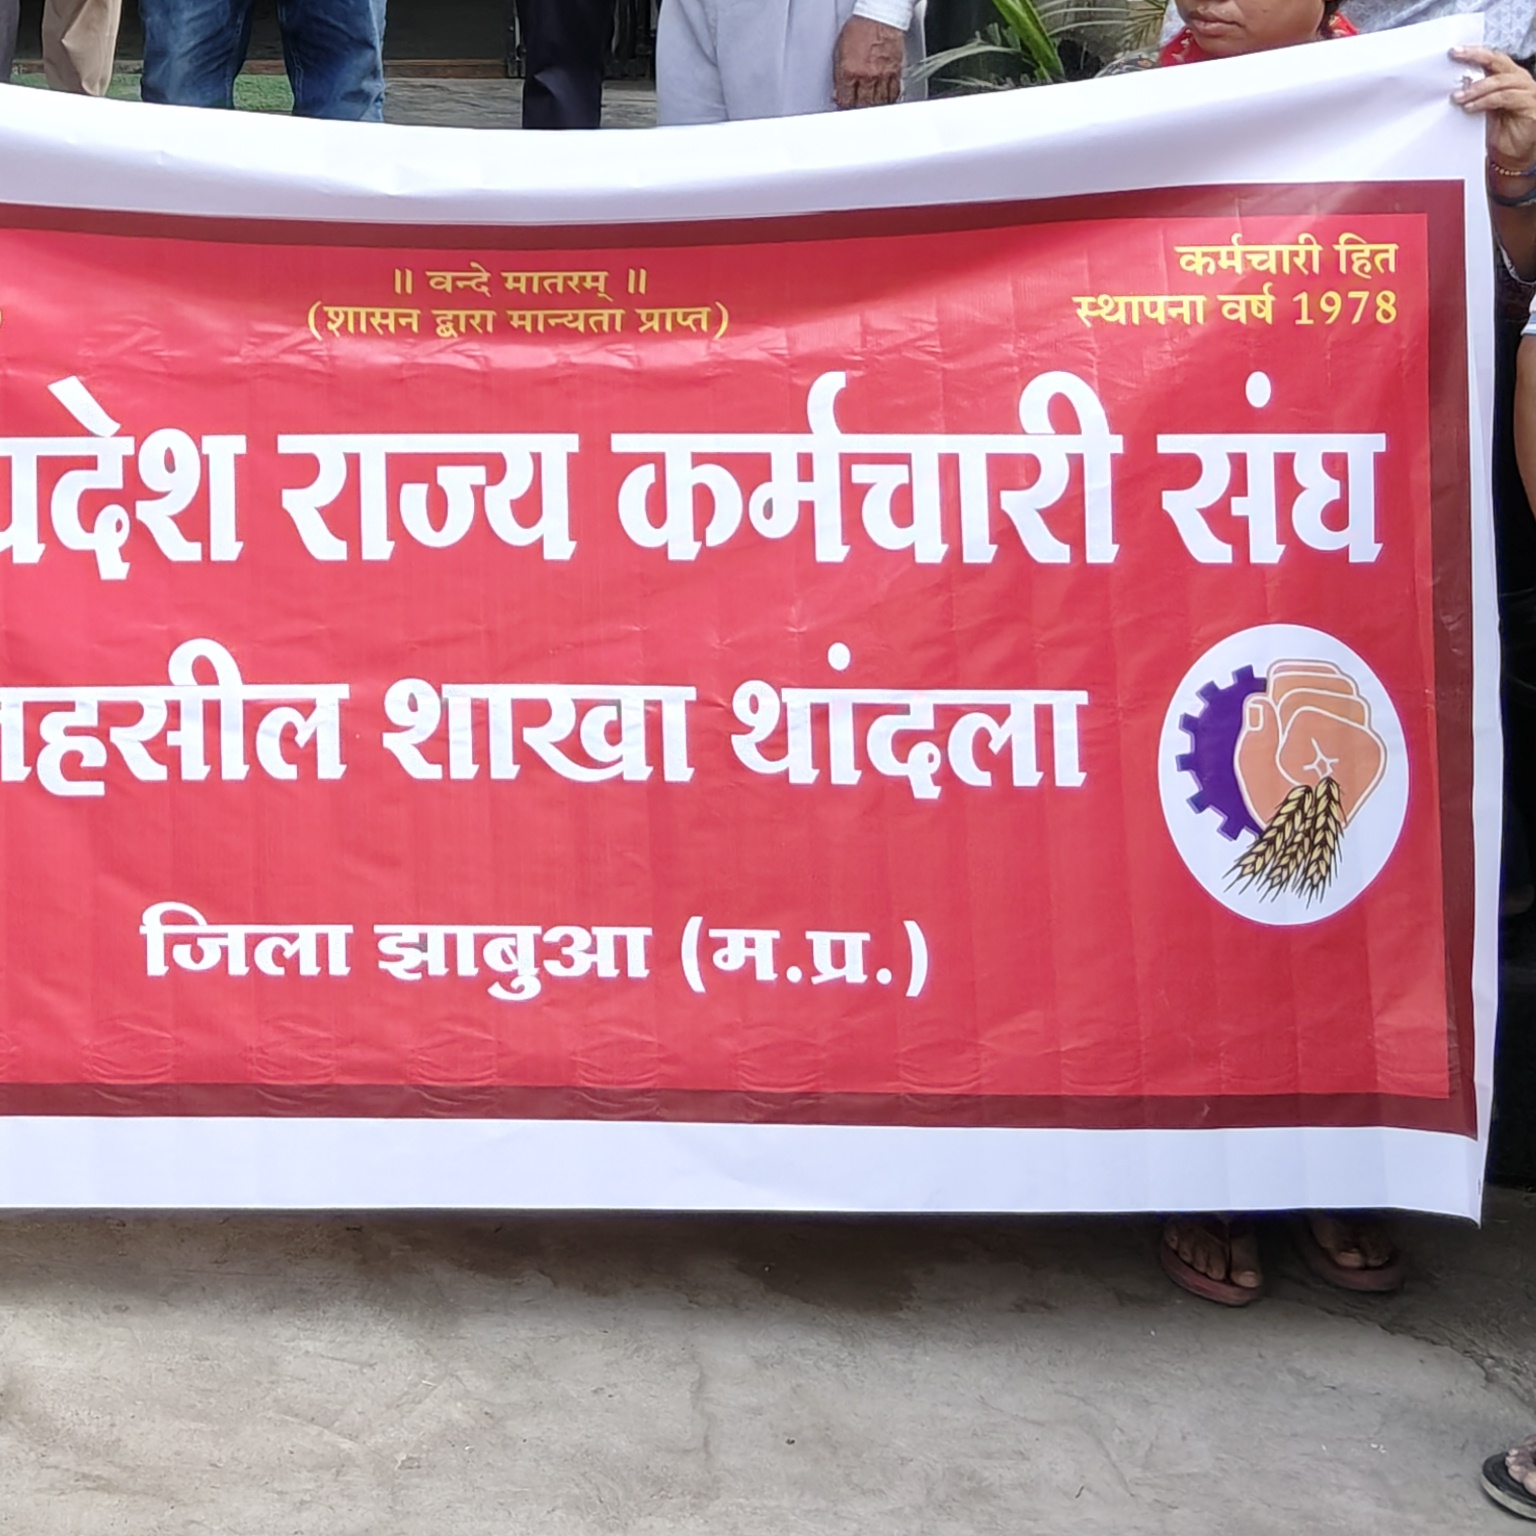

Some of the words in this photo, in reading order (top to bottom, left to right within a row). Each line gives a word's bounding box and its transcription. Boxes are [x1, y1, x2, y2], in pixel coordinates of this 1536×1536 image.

[1173, 232, 1324, 277] कर्मचारी
[1333, 232, 1400, 279] हित
[425, 262, 492, 297] वन्दे
[500, 269, 614, 302] मातरम्
[1071, 293, 1207, 329] स्थापना
[1216, 282, 1277, 325] वर्ष
[1292, 289, 1399, 326] 1978
[307, 301, 421, 341] (शासन
[507, 308, 626, 334] मान्यता
[635, 301, 730, 340] प्राप्त)
[276, 433, 579, 561] राज्य
[610, 370, 1124, 564] कर्मचारी
[1156, 371, 1387, 564] संघ
[382, 678, 697, 782] शाखा
[730, 642, 1089, 799] थांदला
[139, 901, 354, 977] जिला
[373, 924, 653, 1001] झाबुआ
[680, 916, 929, 997] (म.प्र.)
